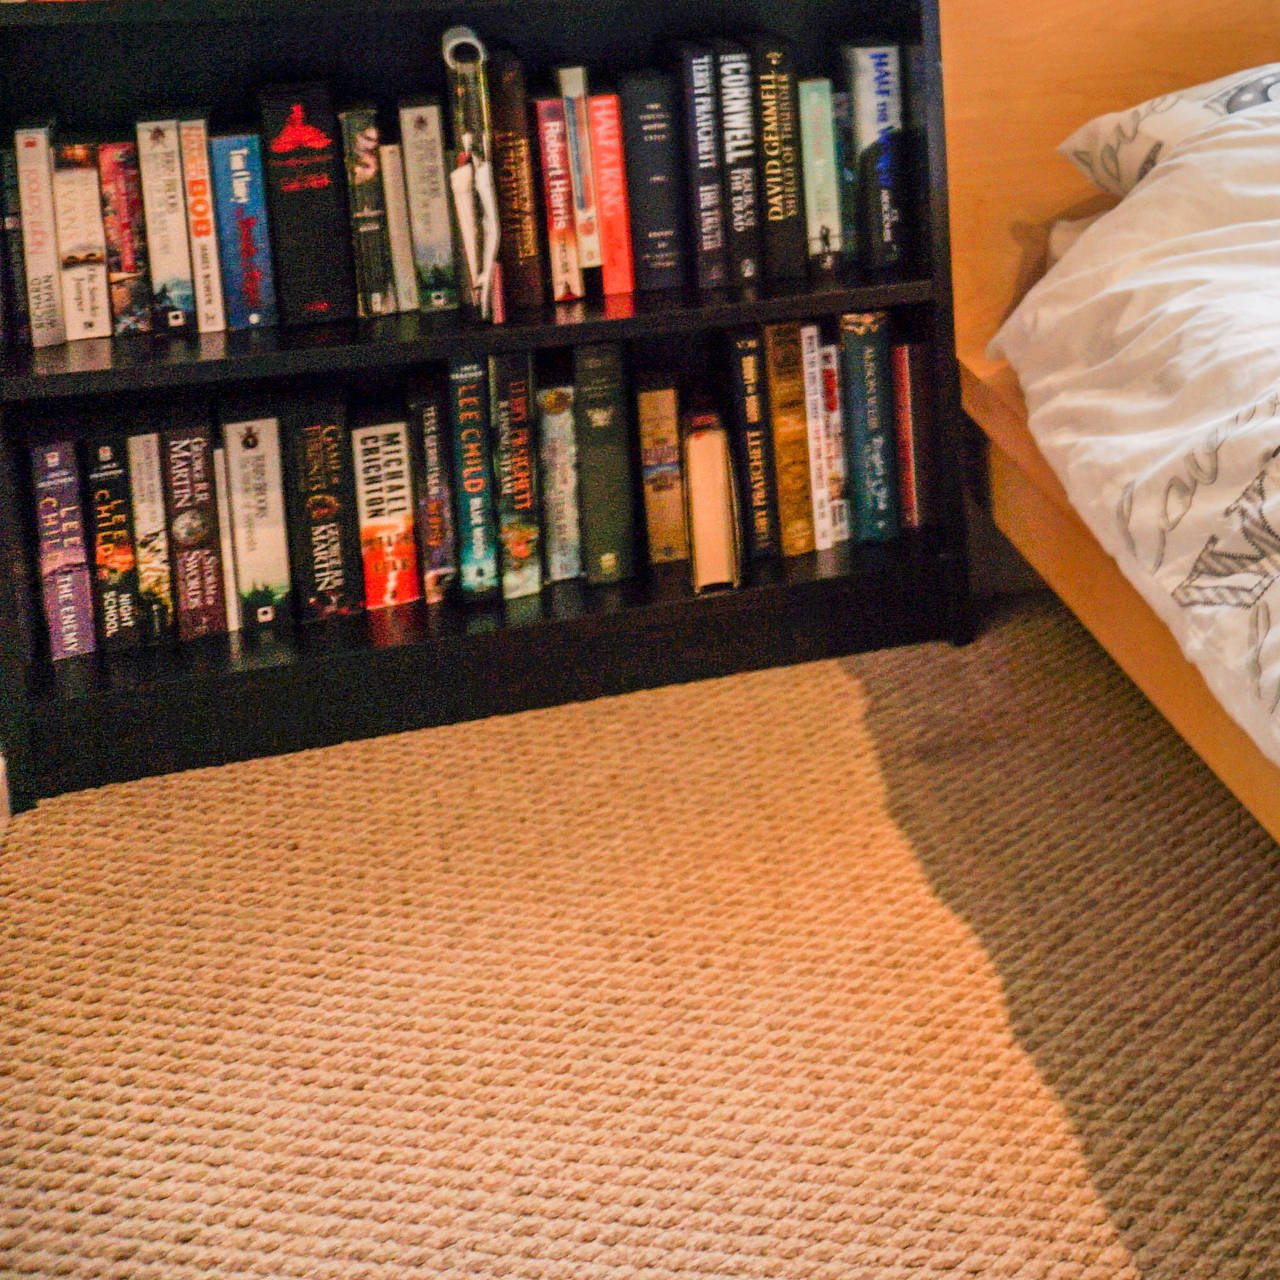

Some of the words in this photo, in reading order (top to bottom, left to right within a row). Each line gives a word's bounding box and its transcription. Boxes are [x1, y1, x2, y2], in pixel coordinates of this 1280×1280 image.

[691, 54, 712, 95] TERRY
[868, 52, 891, 98] HALF
[591, 99, 615, 148] HALF
[695, 96, 718, 169] PRATCHETT
[720, 62, 756, 165] CORNWELL
[759, 70, 782, 156] GEMMELL
[543, 120, 566, 178] Robert
[187, 178, 212, 238] BOB
[548, 178, 569, 231] Harris
[765, 159, 785, 221] DAVID
[456, 382, 480, 424] LEE
[168, 437, 193, 510] MARTIN
[360, 434, 387, 520] CRICHTON
[381, 431, 409, 517] MICHAEL
[460, 425, 486, 493] CHILD
[747, 431, 767, 507] PRATCHETT
[38, 496, 62, 564] CHILD
[60, 504, 81, 548] LEE
[94, 489, 115, 558] CHILD
[110, 499, 127, 541] LEE
[57, 574, 73, 602] THE
[311, 524, 331, 592] MARTIN
[60, 604, 79, 654] ENEMY
[103, 590, 119, 639] SCHOOL
[118, 593, 134, 628] NIGHT
